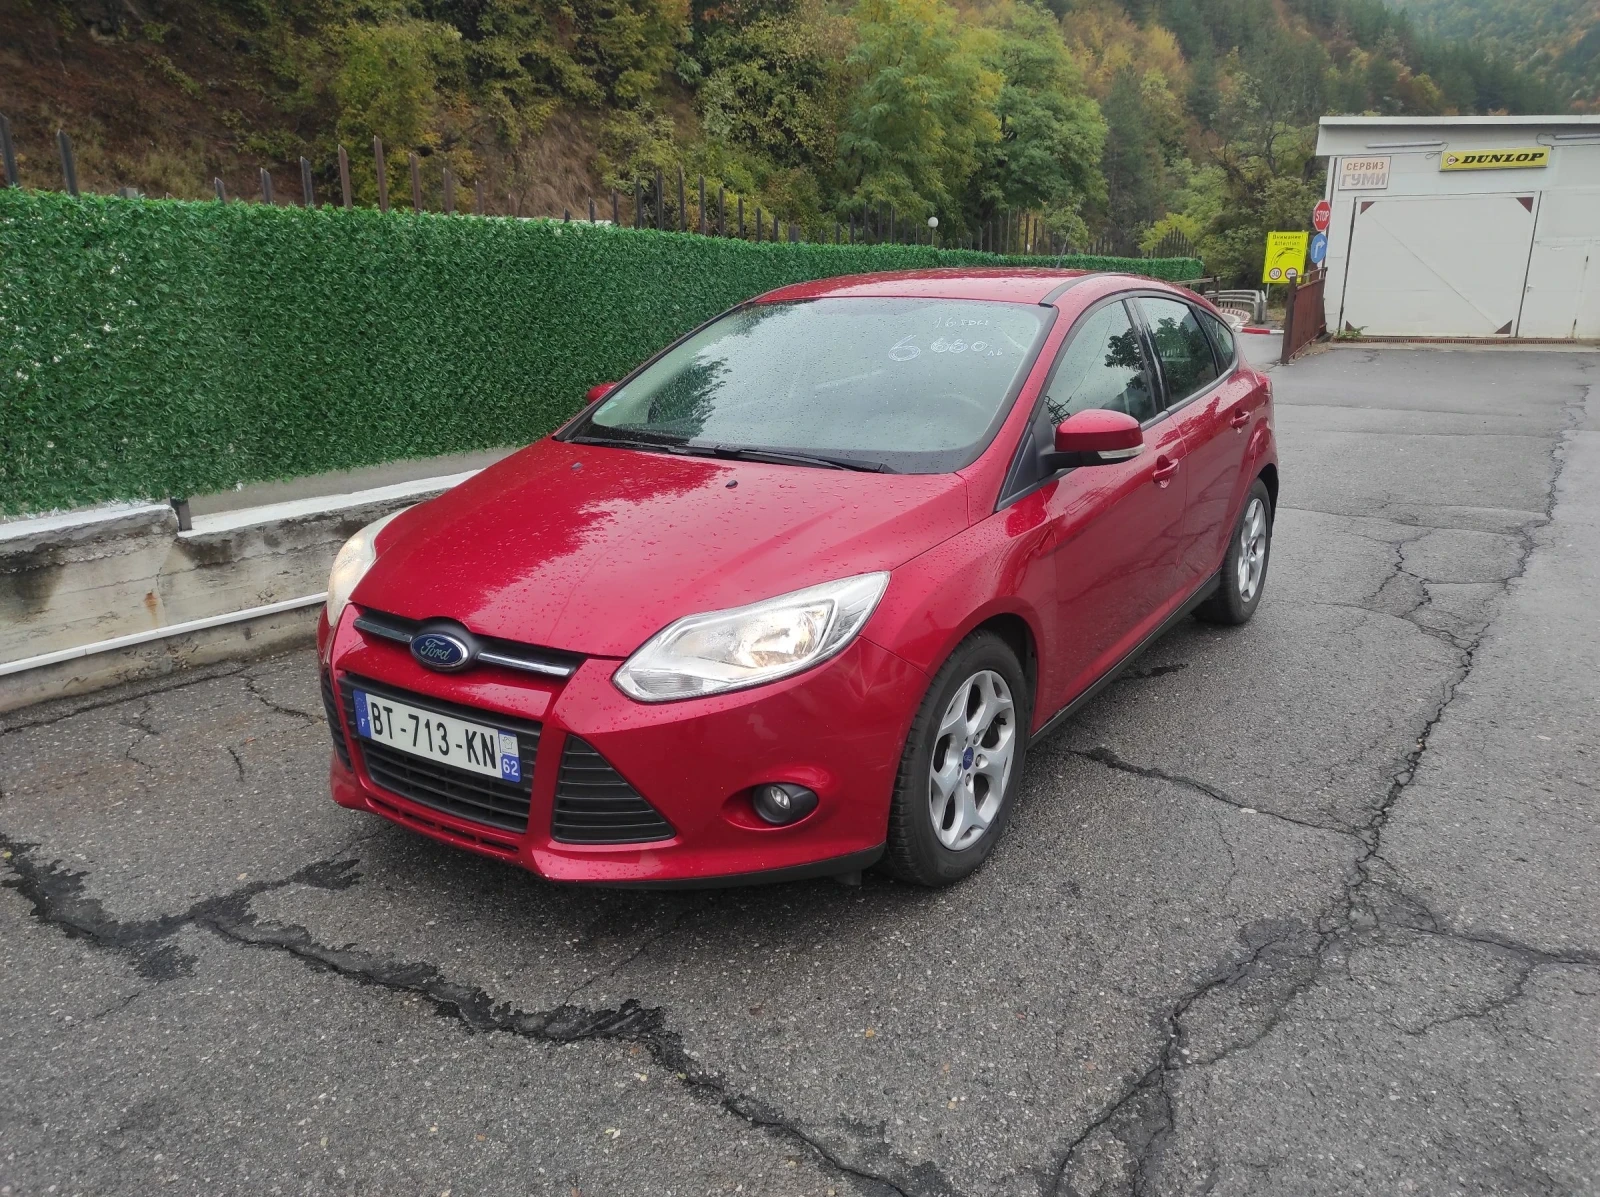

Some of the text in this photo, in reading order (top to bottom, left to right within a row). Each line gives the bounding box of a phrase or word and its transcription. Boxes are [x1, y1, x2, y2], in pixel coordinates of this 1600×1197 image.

[1461, 152, 1545, 164] DUNLOP
[1346, 161, 1385, 172] СЕРВИЗ
[1341, 172, 1387, 187] ГУМИ
[1315, 210, 1330, 222] STOP
[420, 638, 452, 661] Ford
[361, 718, 366, 728] F
[370, 702, 498, 770] BT-713-KN
[502, 758, 519, 777] 62
